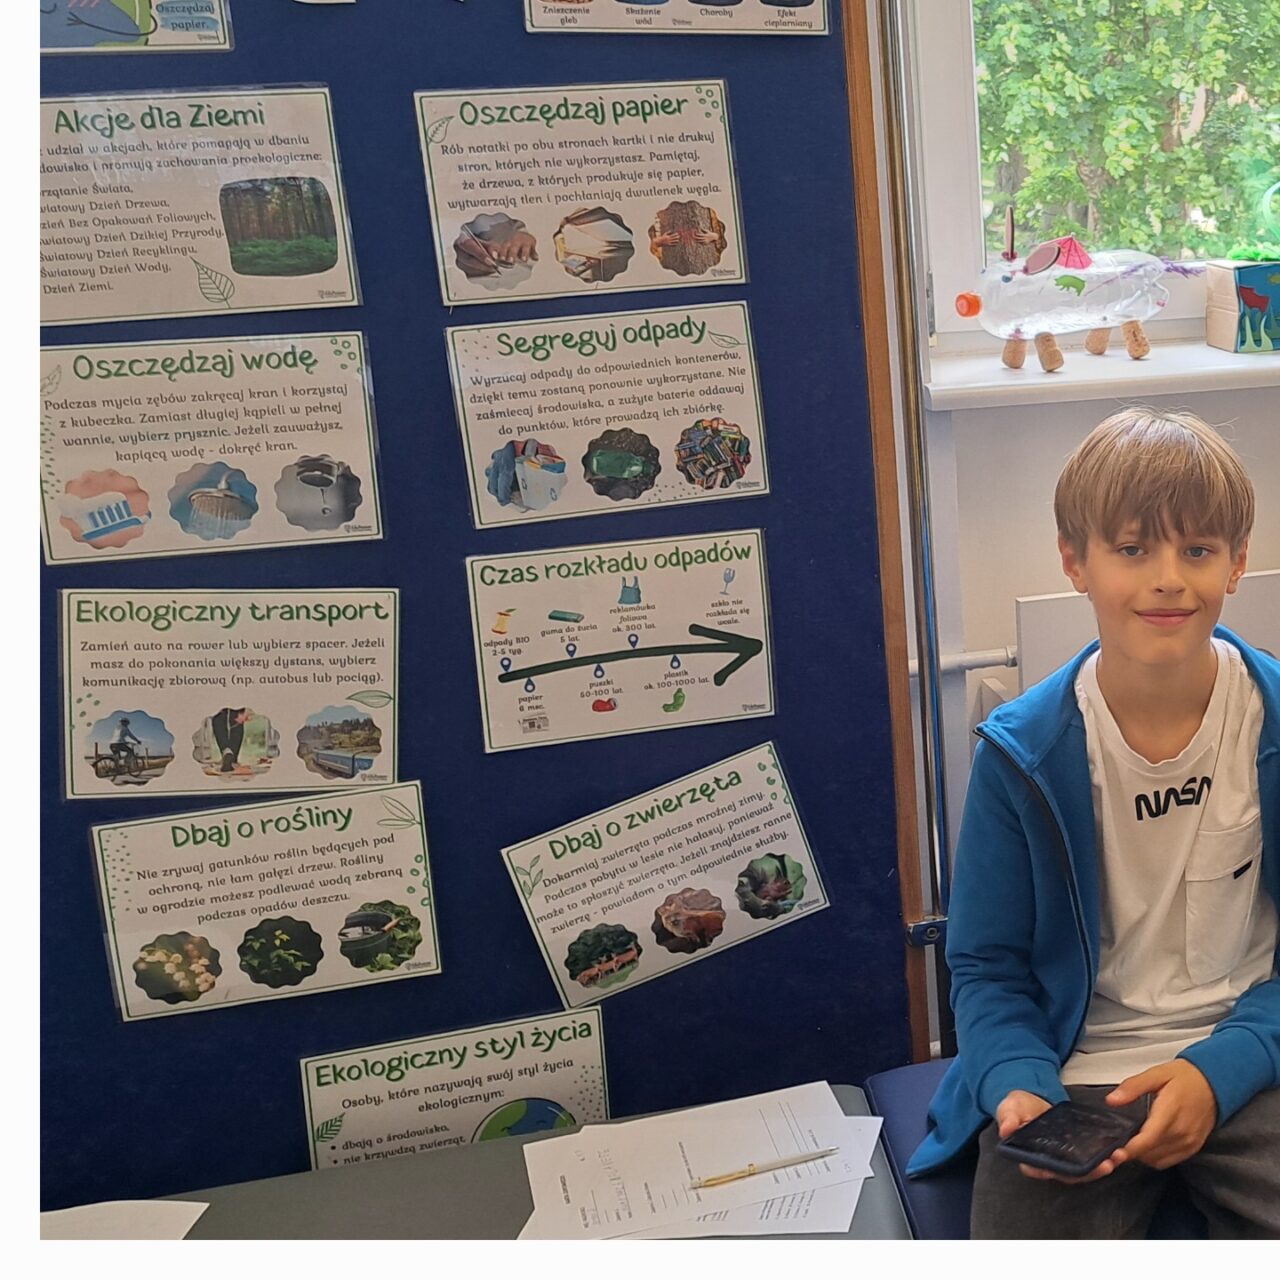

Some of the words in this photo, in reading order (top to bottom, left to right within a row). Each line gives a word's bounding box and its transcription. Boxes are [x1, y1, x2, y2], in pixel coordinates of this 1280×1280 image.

[155, 3, 215, 14] Oszczędzaj
[543, 6, 590, 16] Zniszczenie
[700, 8, 733, 19] Choroby
[764, 19, 813, 29] cieplarniany
[55, 108, 136, 138] Akcje
[140, 104, 182, 130] dla
[188, 102, 266, 128] Ziemi
[459, 96, 606, 128] Oszczędzaj
[612, 94, 689, 126] papier
[46, 144, 84, 156] udział
[157, 140, 188, 150] które
[192, 137, 251, 151] pomagają
[268, 135, 310, 147] dbaniu
[441, 144, 464, 155] Rób
[468, 142, 510, 154] notatki
[558, 135, 609, 148] stronach
[612, 133, 647, 147] kartki
[678, 131, 715, 145] drukuj
[101, 160, 153, 171] promują
[156, 156, 228, 169] zachowania
[232, 152, 323, 166] proekologiczne:
[495, 158, 541, 172] których
[538, 173, 583, 188] których
[586, 169, 643, 186] produkuje
[89, 200, 121, 211] Dzień
[448, 196, 518, 211] wytwarzają
[521, 193, 543, 205] tlen
[554, 188, 623, 205] pochłaniają
[626, 185, 683, 198] dwutlenek
[69, 218, 90, 229] Bez
[497, 323, 617, 361] Segreguj
[622, 314, 706, 348] odpady
[73, 349, 235, 382] Oszczędzaj
[240, 344, 319, 375] wodę
[470, 372, 527, 387] Wyrzucaj
[530, 367, 574, 382] odpady
[594, 355, 671, 375] odpowiednich
[44, 398, 97, 411] Podczas
[102, 395, 142, 409] mycia
[146, 393, 187, 407] zębów
[191, 390, 245, 403] zakręcaj
[248, 388, 279, 399] kran
[291, 384, 348, 398] korzystaj
[469, 391, 505, 405] dzięki
[508, 387, 537, 400] temu
[541, 384, 585, 398] zostaną
[589, 376, 643, 394] ponownie
[475, 405, 534, 421] zaśmiecaj
[618, 393, 654, 407] zużyte
[657, 389, 695, 402] baterie
[698, 383, 745, 397] oddawaj
[138, 412, 192, 424] Zamiast
[196, 408, 239, 421] długiej
[243, 405, 286, 420] kąpieli
[304, 402, 342, 416] pełnej
[572, 417, 601, 428] które
[605, 410, 659, 426] prowadzą
[118, 431, 170, 445] wybierz
[234, 423, 269, 436] Jeżeli
[115, 450, 168, 463] kapiącą
[171, 446, 205, 459] wodę
[219, 443, 261, 456] dokręć
[480, 564, 540, 587] Czas
[545, 551, 648, 580] rozkładu
[654, 539, 752, 572] odpadów
[76, 600, 241, 631] Ekologiczny
[248, 601, 389, 627] transport
[625, 623, 643, 632] 300
[483, 637, 513, 648] odpady
[516, 635, 530, 644] BIO
[540, 627, 563, 638] guma
[80, 641, 129, 651] Zamień
[133, 642, 162, 651] auto
[188, 641, 224, 651] rower
[252, 639, 302, 652] wybierz
[351, 638, 385, 649] Jeżeli
[90, 660, 124, 669] masz
[149, 657, 216, 671] pokonania
[220, 656, 270, 670] większy
[329, 655, 377, 668] wybierz
[664, 670, 689, 680] plastik
[82, 676, 165, 689] komunikację
[169, 674, 227, 688] zbiorową
[259, 673, 309, 684] autobus
[657, 677, 696, 689] 100-1000
[518, 695, 543, 704] papier
[1134, 775, 1212, 821] NASA
[171, 819, 231, 848] Dbaj
[236, 821, 255, 839] o
[260, 806, 353, 835] rośliny
[548, 823, 602, 860] Dbaj
[606, 821, 622, 837] o
[624, 771, 742, 830] zwierzęta
[162, 862, 204, 878] zrywaj
[208, 854, 270, 873] gatunków
[274, 847, 309, 861] roślin
[312, 837, 369, 856] będących
[542, 858, 600, 888] Dokarmiaj
[601, 838, 650, 865] zwierzęta
[653, 820, 693, 845] podczas
[696, 803, 737, 826] mroźnej
[544, 881, 587, 904] Podczas
[589, 865, 627, 888] pobytu
[727, 801, 775, 831] ponieważ
[258, 866, 294, 882] gałęzi
[340, 853, 384, 868] Rośliny
[581, 881, 626, 906] spłoszyć
[710, 825, 761, 852] znajdziesz
[152, 898, 206, 914] ogrodzie
[210, 891, 255, 904] możesz
[258, 881, 316, 899] podlewać
[319, 875, 352, 888] wodą
[355, 868, 403, 882] zebraną
[601, 886, 656, 915] powiadom
[690, 845, 753, 877] odpowiednie
[197, 907, 247, 925] podczas
[250, 899, 298, 916] opadów
[315, 1046, 467, 1087] Ekologiczny
[474, 1031, 526, 1060] styl
[531, 1020, 592, 1053] życia
[388, 1087, 419, 1101] które
[424, 1076, 483, 1094] nazywają
[487, 1069, 514, 1083] swój
[517, 1063, 539, 1077] styl
[543, 1058, 574, 1073] życia
[418, 1089, 505, 1113] ekologicznym:
[342, 1137, 373, 1151] dbają
[364, 1145, 416, 1162] krzywdzą
